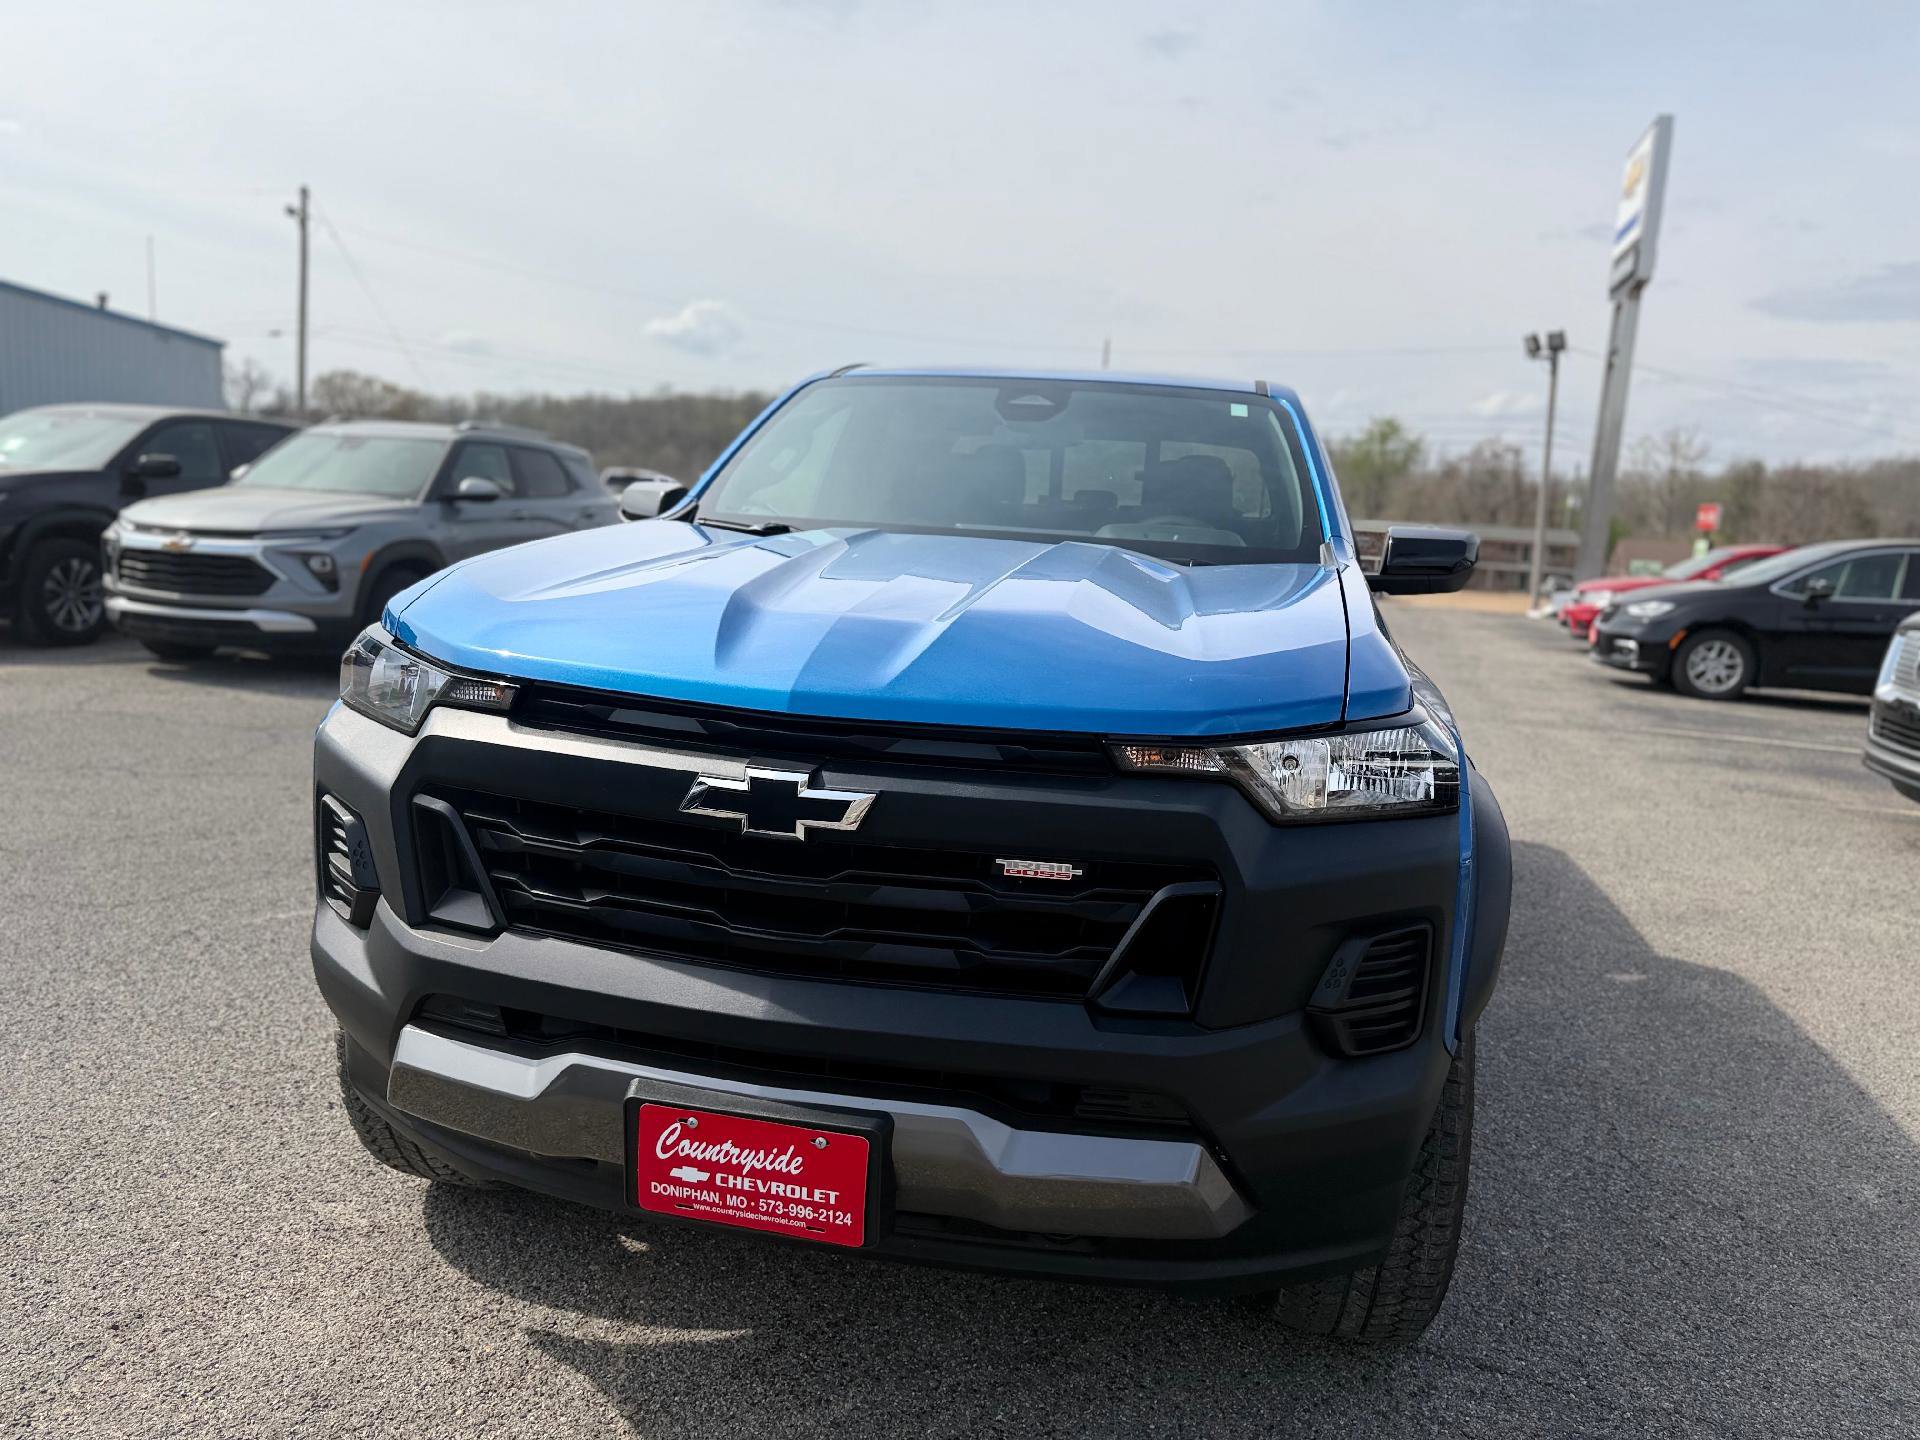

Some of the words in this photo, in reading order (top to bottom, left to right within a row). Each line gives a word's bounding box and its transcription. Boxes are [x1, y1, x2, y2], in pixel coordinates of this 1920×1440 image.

[1004, 868, 1072, 880] BOSS
[655, 1122, 803, 1175] Countryside
[650, 1181, 723, 1205] DONIPHAN,
[726, 1195, 747, 1209] MO
[758, 1198, 852, 1227] 573-996-2124
[715, 1173, 840, 1205] CHEVROLET
[693, 1202, 806, 1228] www.countrysidechevrolet.com
